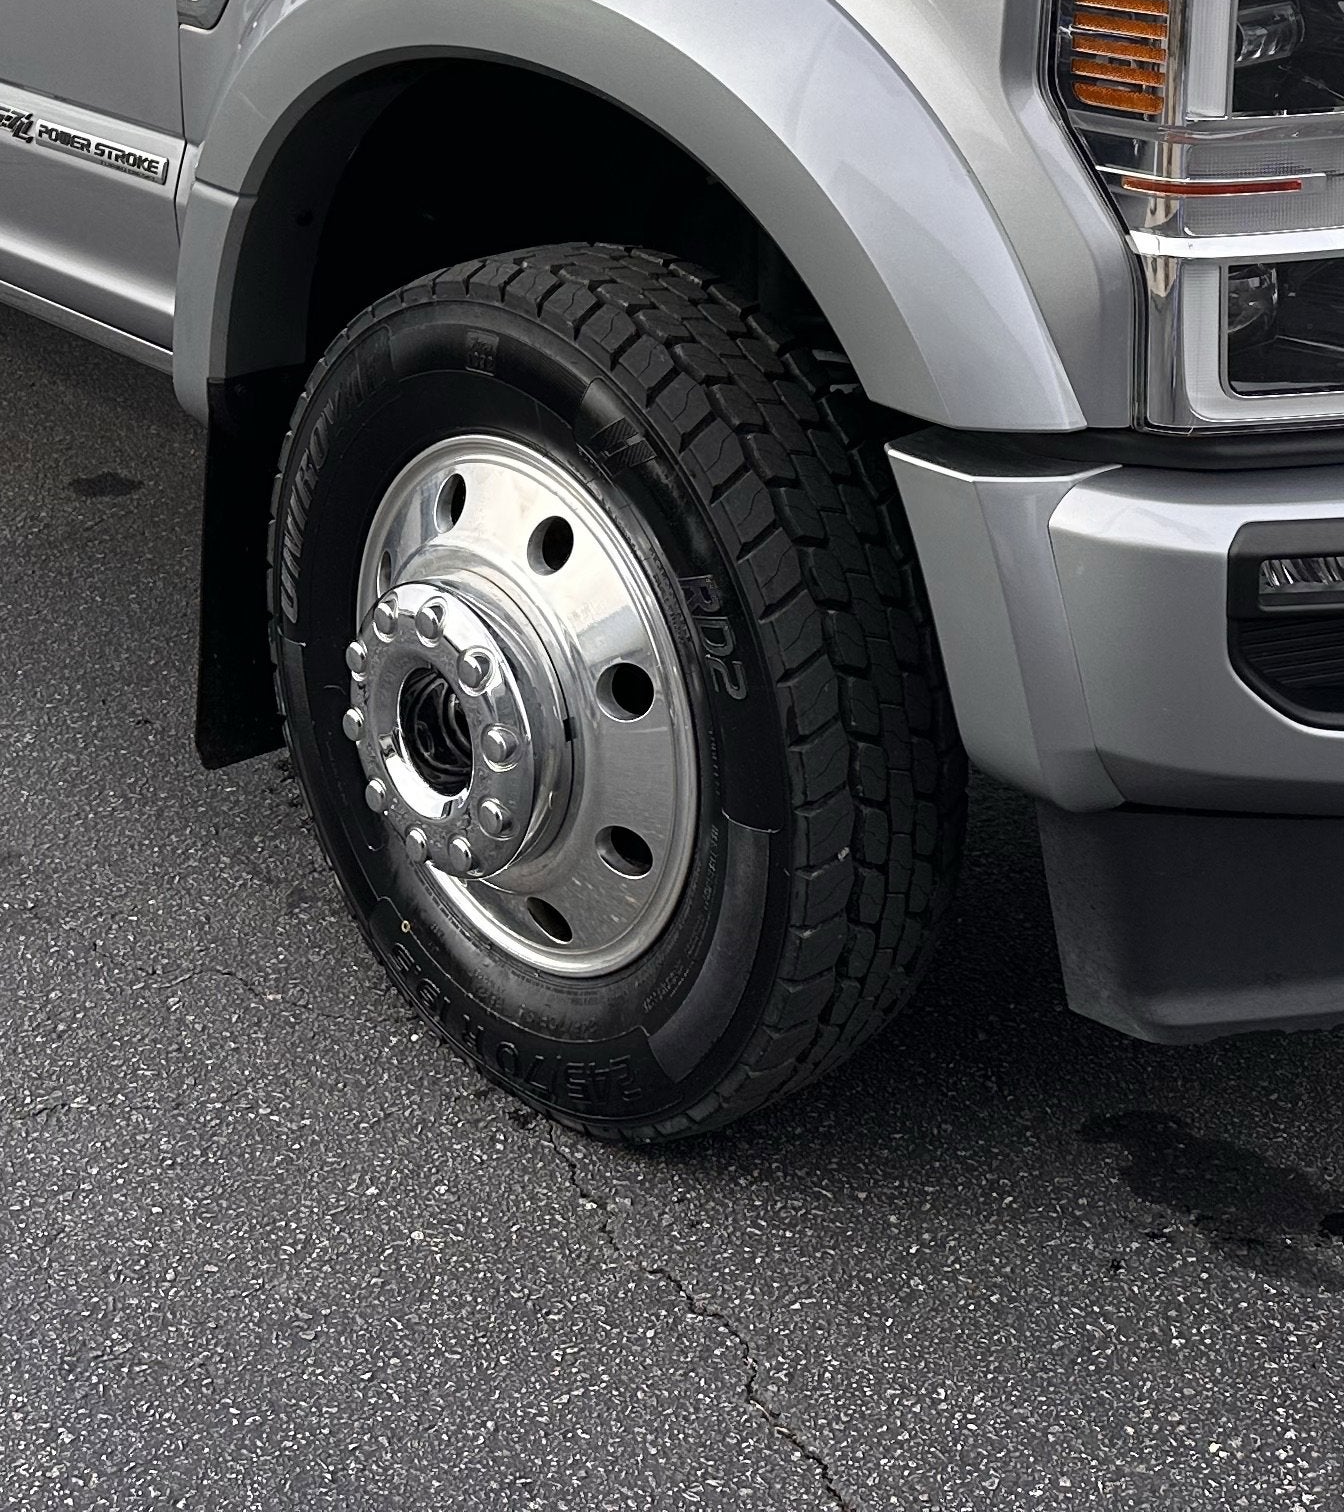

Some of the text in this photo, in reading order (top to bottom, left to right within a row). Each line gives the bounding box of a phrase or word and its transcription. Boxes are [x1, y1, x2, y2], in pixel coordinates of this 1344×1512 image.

[38, 125, 92, 154] POWER
[94, 142, 160, 175] STROKE
[679, 574, 748, 700] RD2
